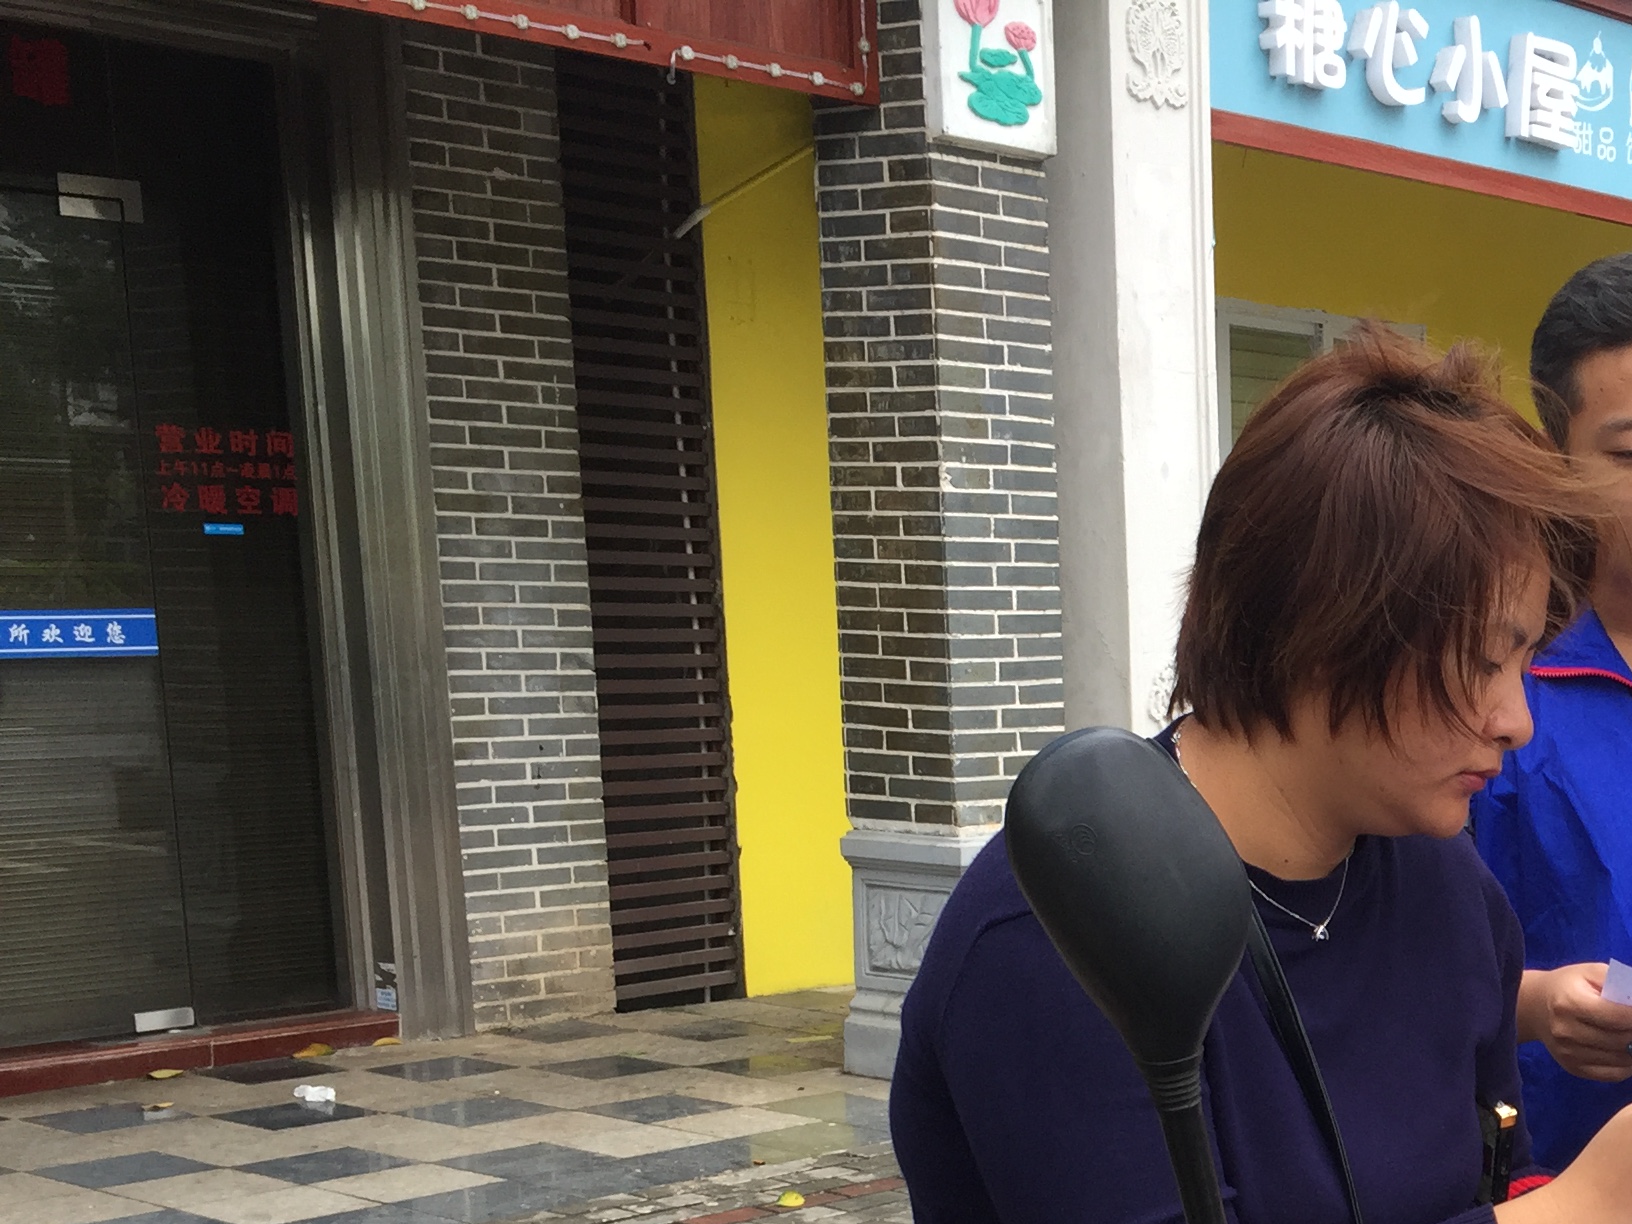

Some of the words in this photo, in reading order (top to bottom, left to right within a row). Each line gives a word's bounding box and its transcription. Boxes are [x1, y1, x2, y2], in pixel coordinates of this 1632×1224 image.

[1259, 0, 1581, 151] 糖心小屋
[1574, 121, 1617, 163] 甜品
[155, 423, 295, 458] 营业时间
[161, 482, 299, 516] 冷暖空调
[8, 620, 126, 646] 所欢迎您
